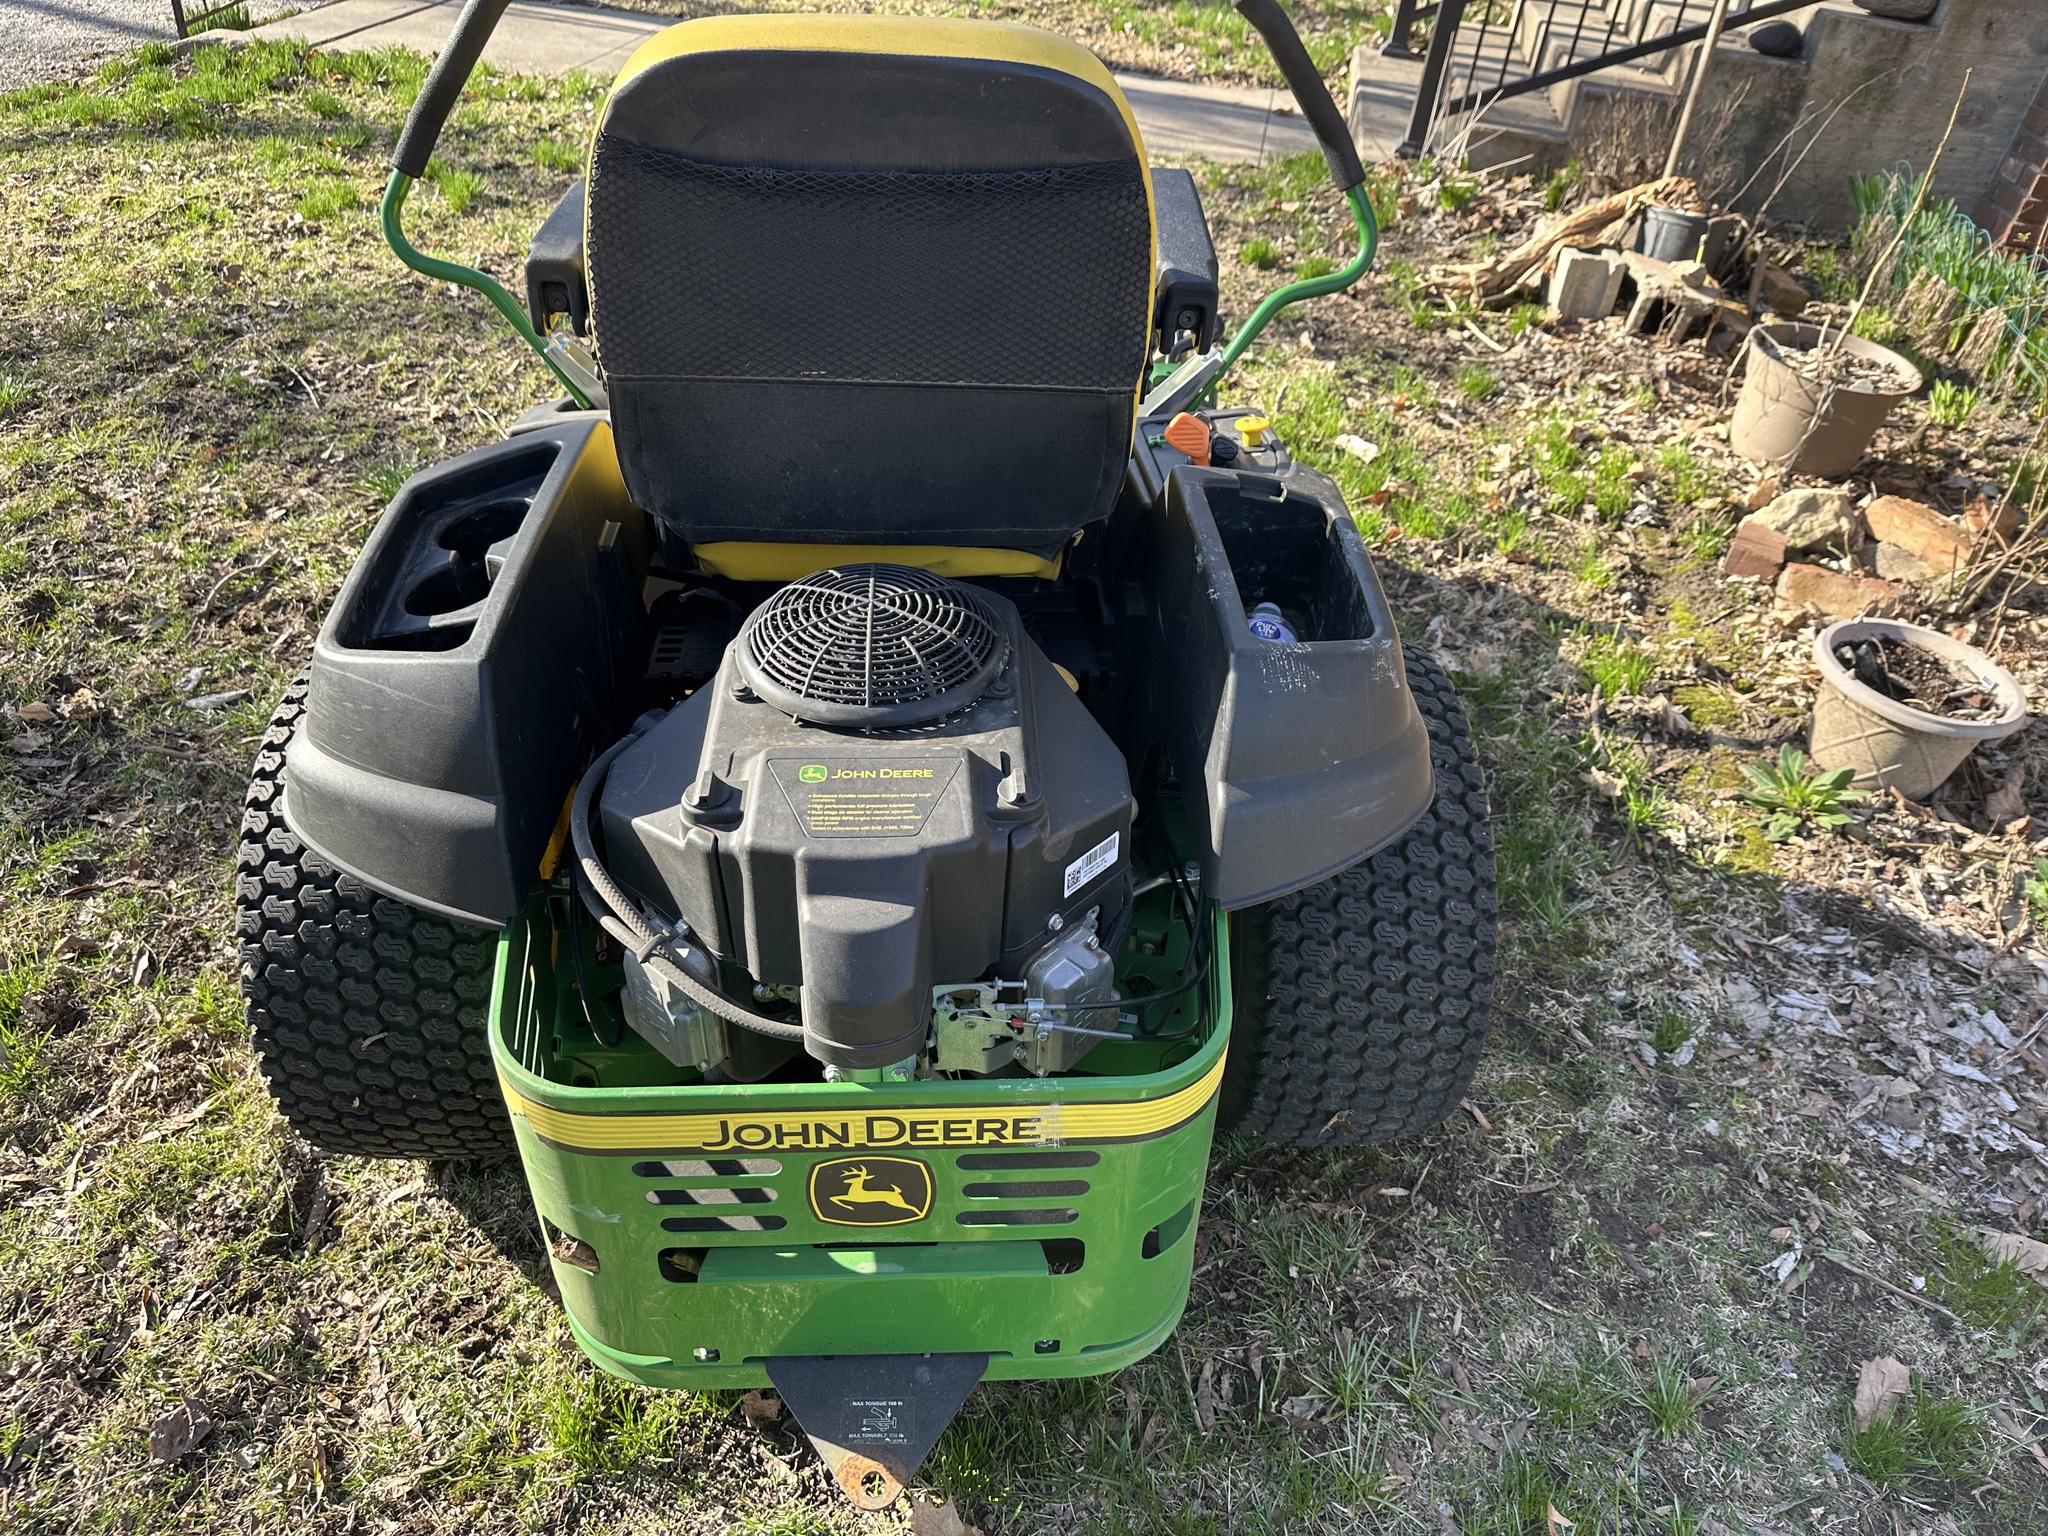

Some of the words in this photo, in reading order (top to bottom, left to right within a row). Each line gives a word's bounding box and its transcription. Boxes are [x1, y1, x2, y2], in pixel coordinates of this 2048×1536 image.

[1256, 621, 1278, 631] Pure
[1258, 626, 1275, 635] Life
[831, 769, 876, 779] JOHN
[879, 768, 933, 779] DEERE
[702, 1119, 848, 1148] JOHN
[865, 1116, 1042, 1145] DEERE
